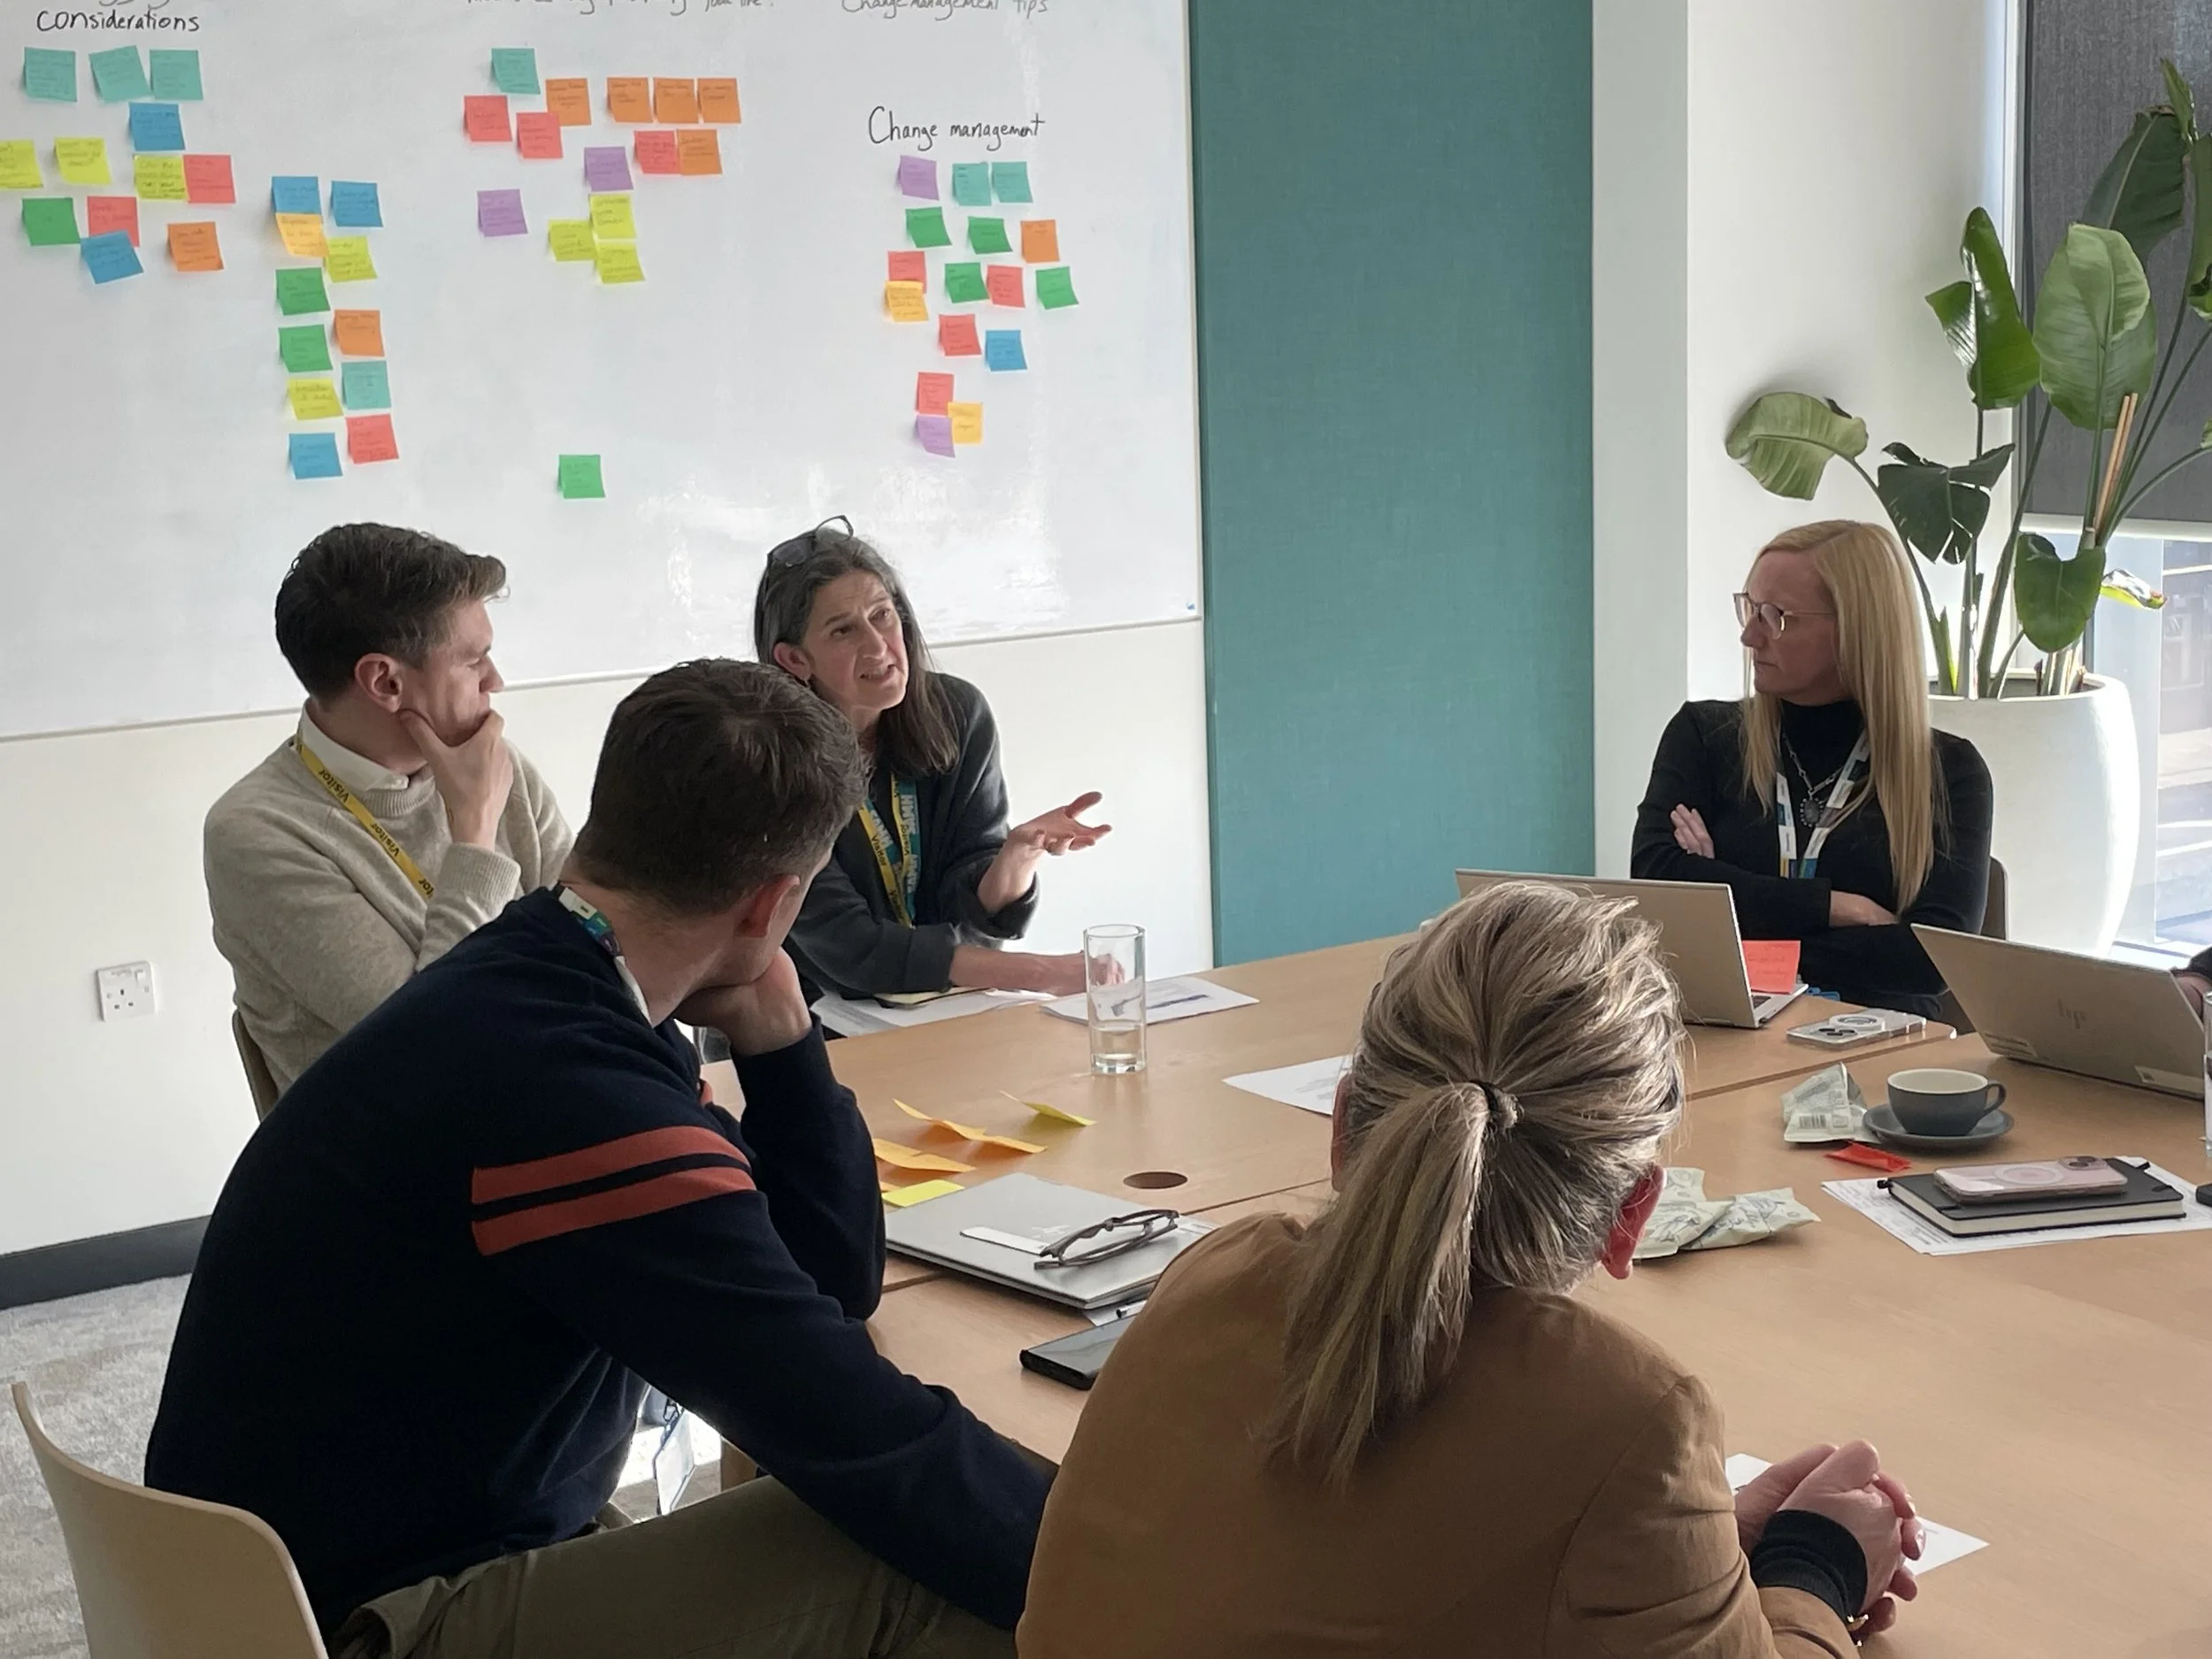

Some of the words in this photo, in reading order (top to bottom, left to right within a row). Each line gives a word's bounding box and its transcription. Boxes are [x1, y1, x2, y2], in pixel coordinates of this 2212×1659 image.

[868, 105, 938, 151] Change
[949, 112, 1046, 151] management
[319, 768, 349, 803] Visitor
[371, 823, 401, 857] Visitor
[871, 834, 887, 866] Visitor
